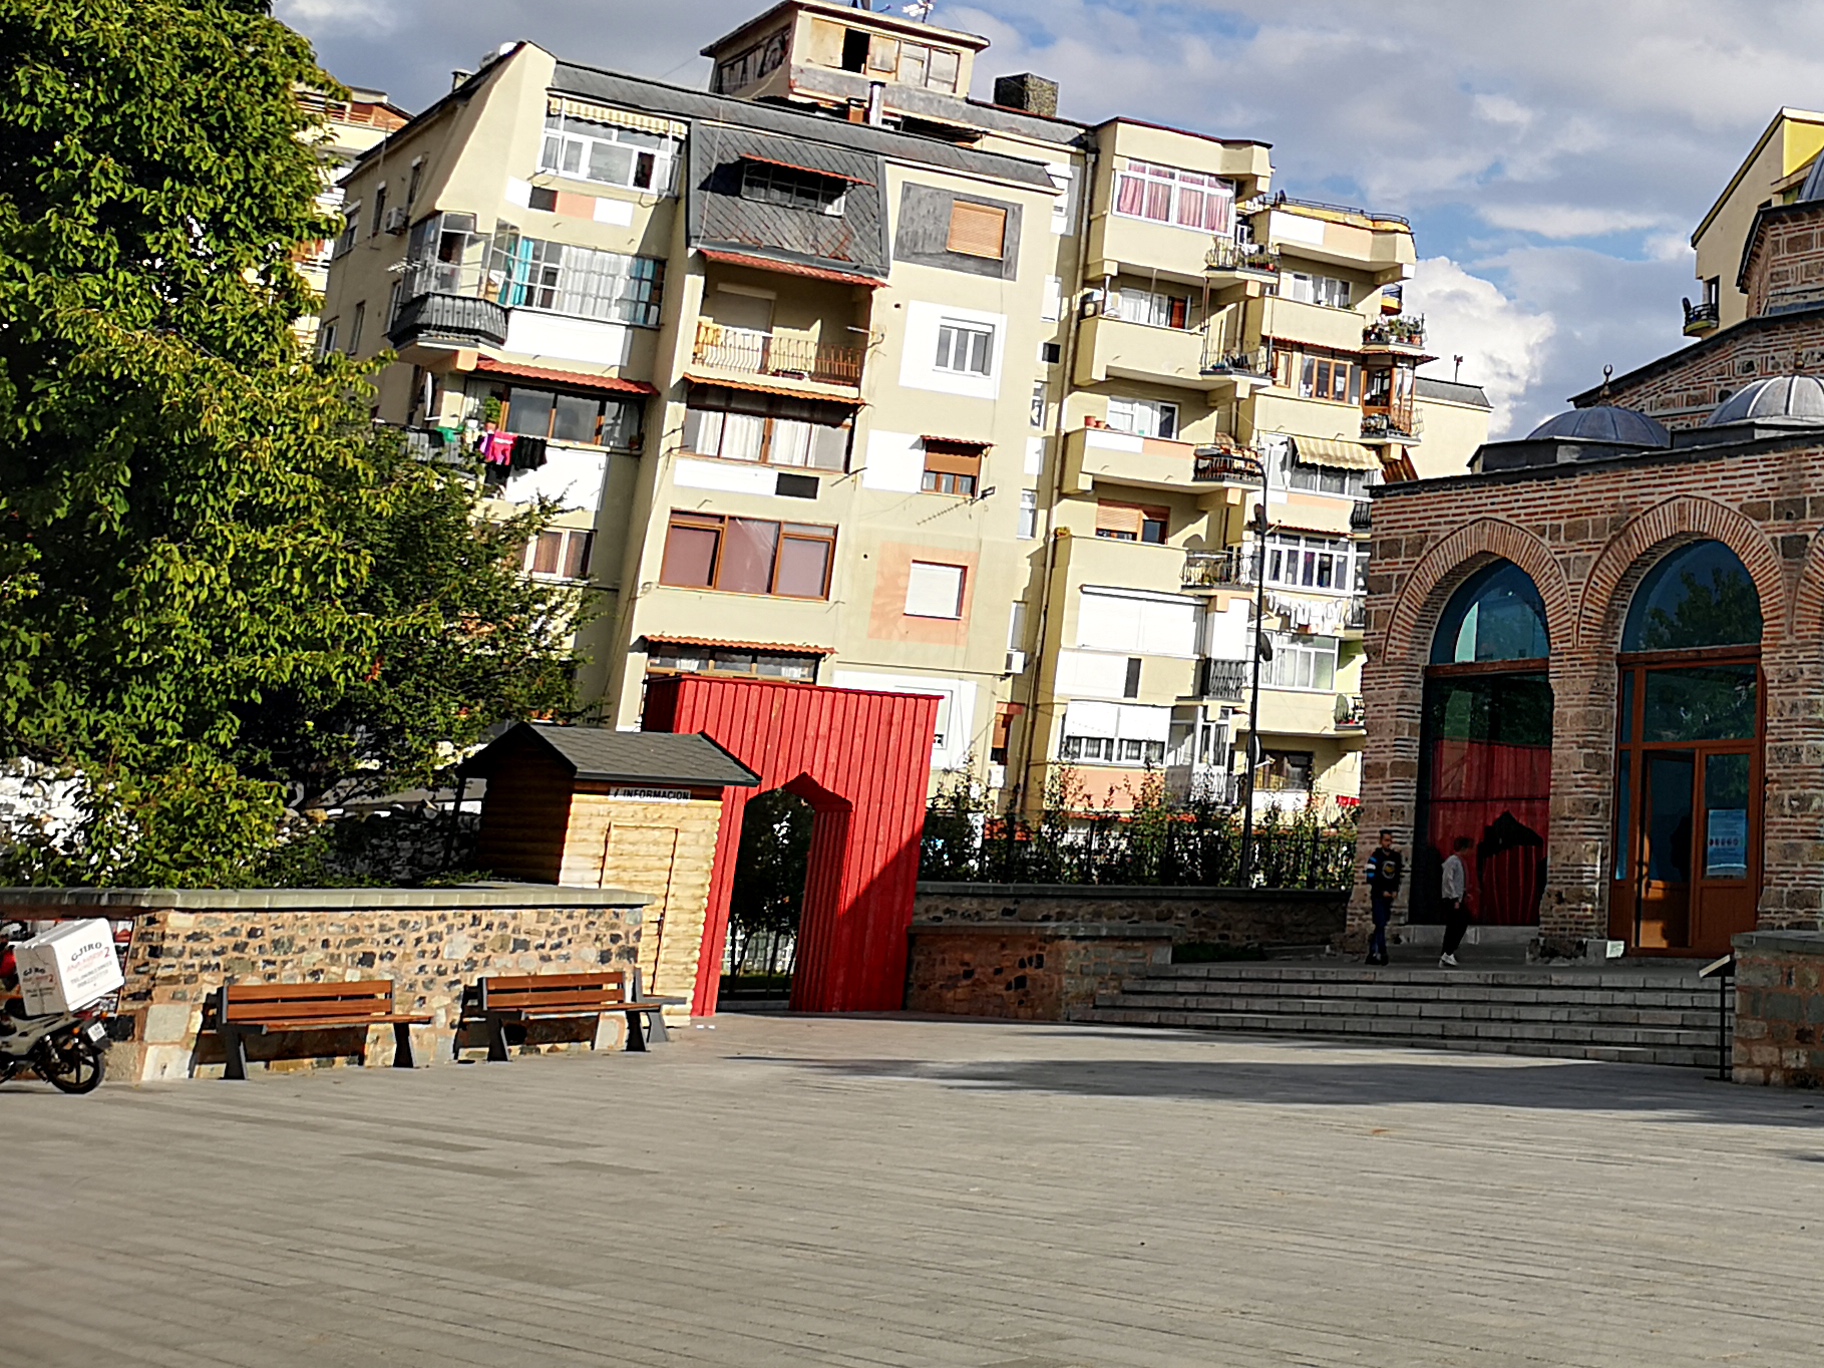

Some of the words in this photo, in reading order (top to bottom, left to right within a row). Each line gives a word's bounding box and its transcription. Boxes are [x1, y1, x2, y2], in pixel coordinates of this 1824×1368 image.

[71, 941, 102, 962] GJIRO
[104, 946, 110, 958] 2
[23, 967, 46, 977] GJRO
